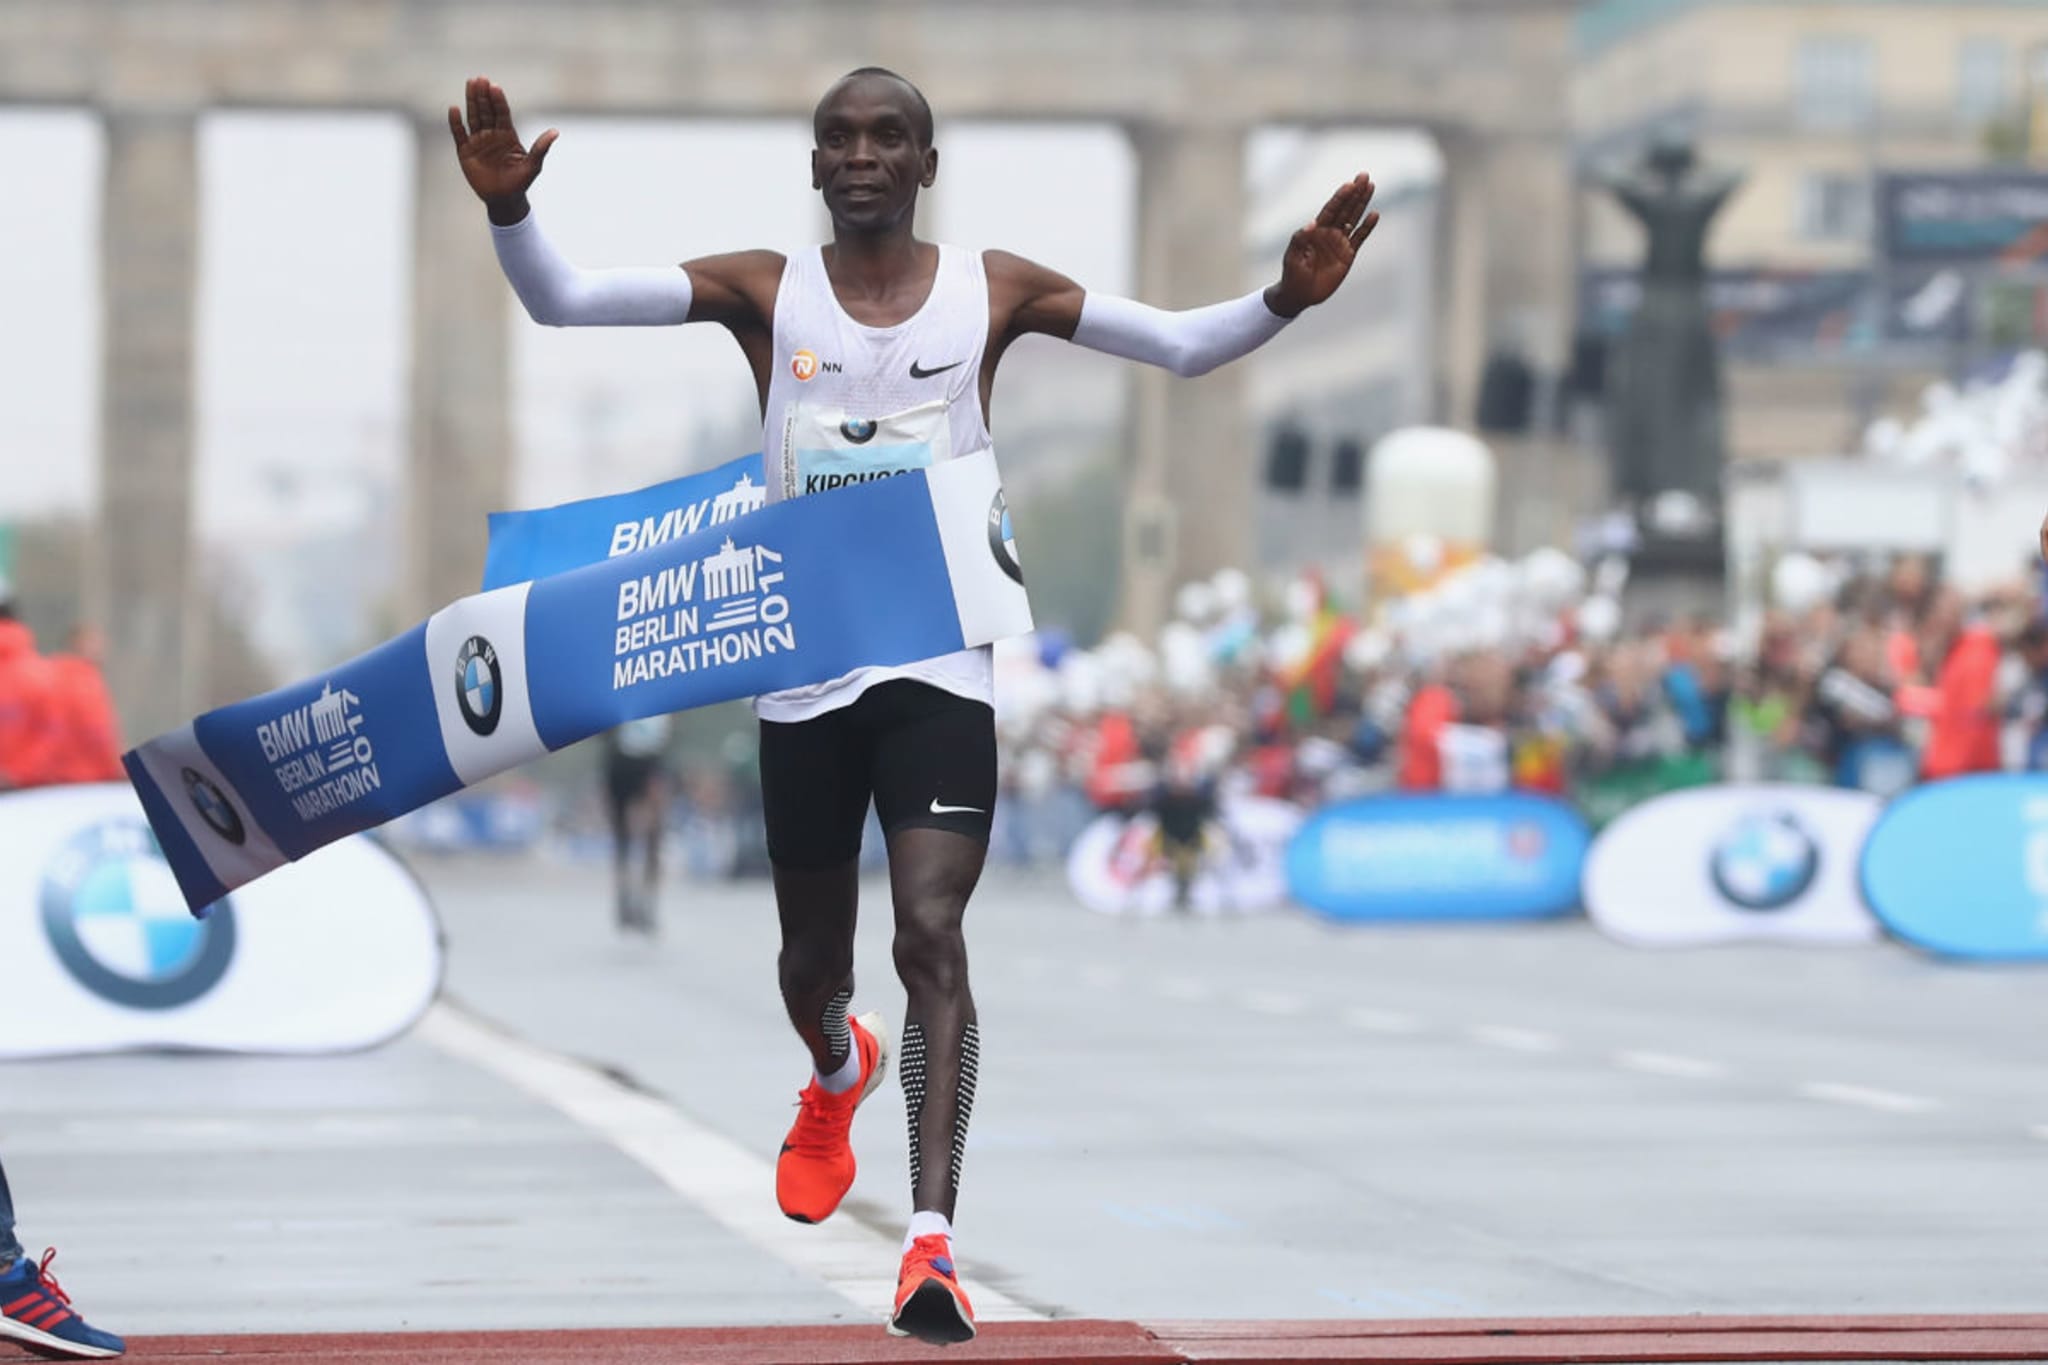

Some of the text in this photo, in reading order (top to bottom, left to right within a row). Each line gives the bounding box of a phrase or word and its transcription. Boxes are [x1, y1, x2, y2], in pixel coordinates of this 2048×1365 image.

[821, 360, 843, 374] NN
[609, 498, 711, 558] BMW
[617, 560, 699, 622] BMW
[754, 544, 796, 654] 2017
[613, 628, 763, 691] MARATHON
[614, 606, 699, 656] BERLIN
[256, 705, 311, 763] BMW
[341, 688, 381, 793] 2017
[274, 749, 327, 793] BERLIN
[291, 768, 366, 822] MARATHON
